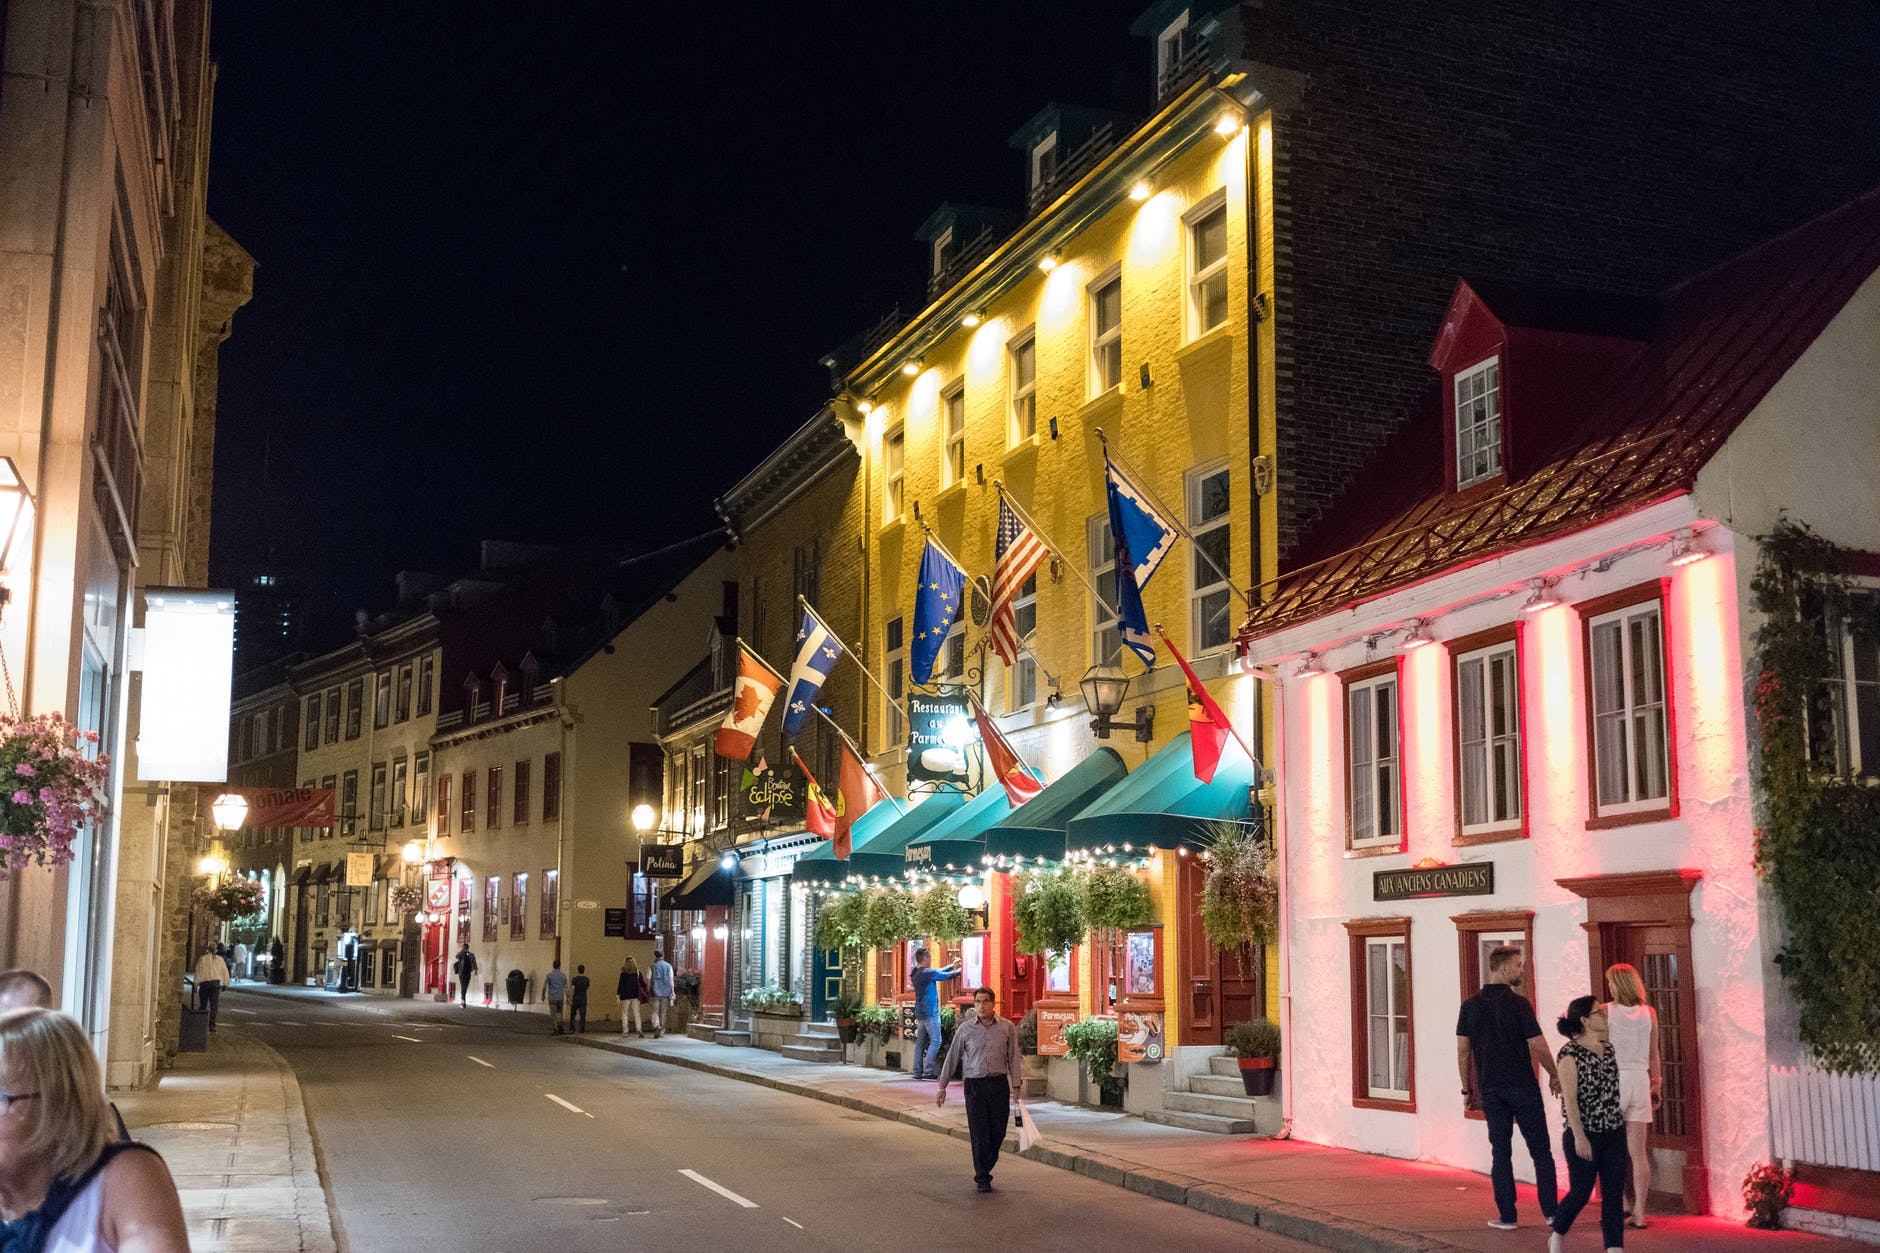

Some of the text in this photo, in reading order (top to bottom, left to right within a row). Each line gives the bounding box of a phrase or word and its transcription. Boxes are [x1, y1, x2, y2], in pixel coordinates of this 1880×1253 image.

[911, 700, 963, 713] Restaurant
[929, 720, 942, 728] au
[646, 856, 677, 872] Polina
[1379, 870, 1487, 894] AUX ANCIENS CANADIENS
[1041, 1011, 1075, 1021] Parmesan
